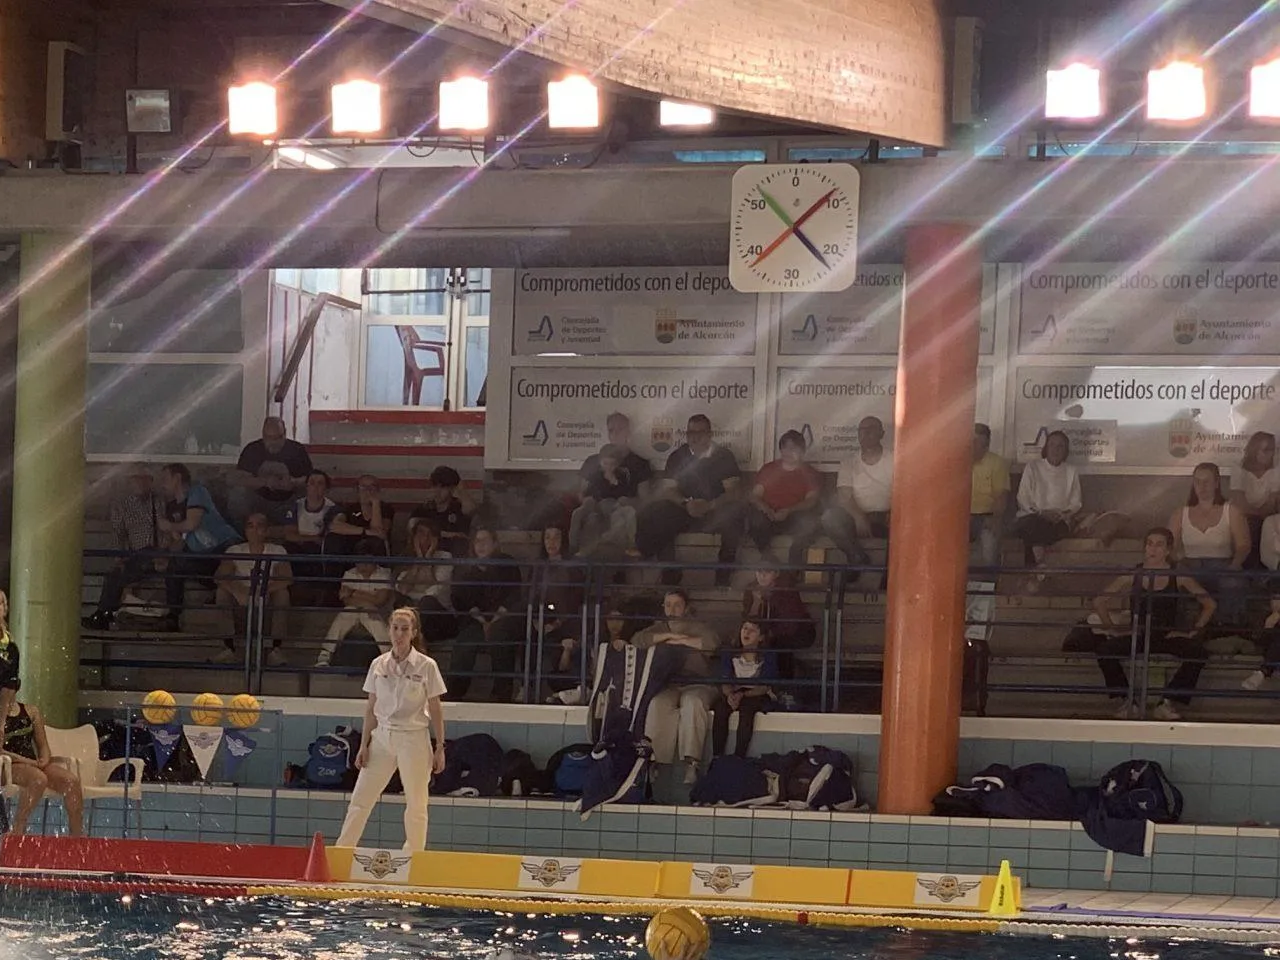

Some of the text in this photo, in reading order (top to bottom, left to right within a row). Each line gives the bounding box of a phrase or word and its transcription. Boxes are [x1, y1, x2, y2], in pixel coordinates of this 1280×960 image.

[792, 176, 800, 187] 0
[750, 200, 766, 210] 50
[826, 198, 840, 209] 10
[748, 245, 763, 256] 40
[823, 244, 839, 255] 20
[783, 269, 799, 280] 30
[521, 271, 734, 297] Comprometidos con el depo
[1163, 274, 1191, 289] con
[1195, 268, 1210, 289] el
[1214, 269, 1279, 295] deporte
[517, 378, 749, 404] Comprometidos con el deporte
[788, 380, 886, 399] Comprometidos
[1022, 378, 1276, 405] Comprometidos con el deporte
